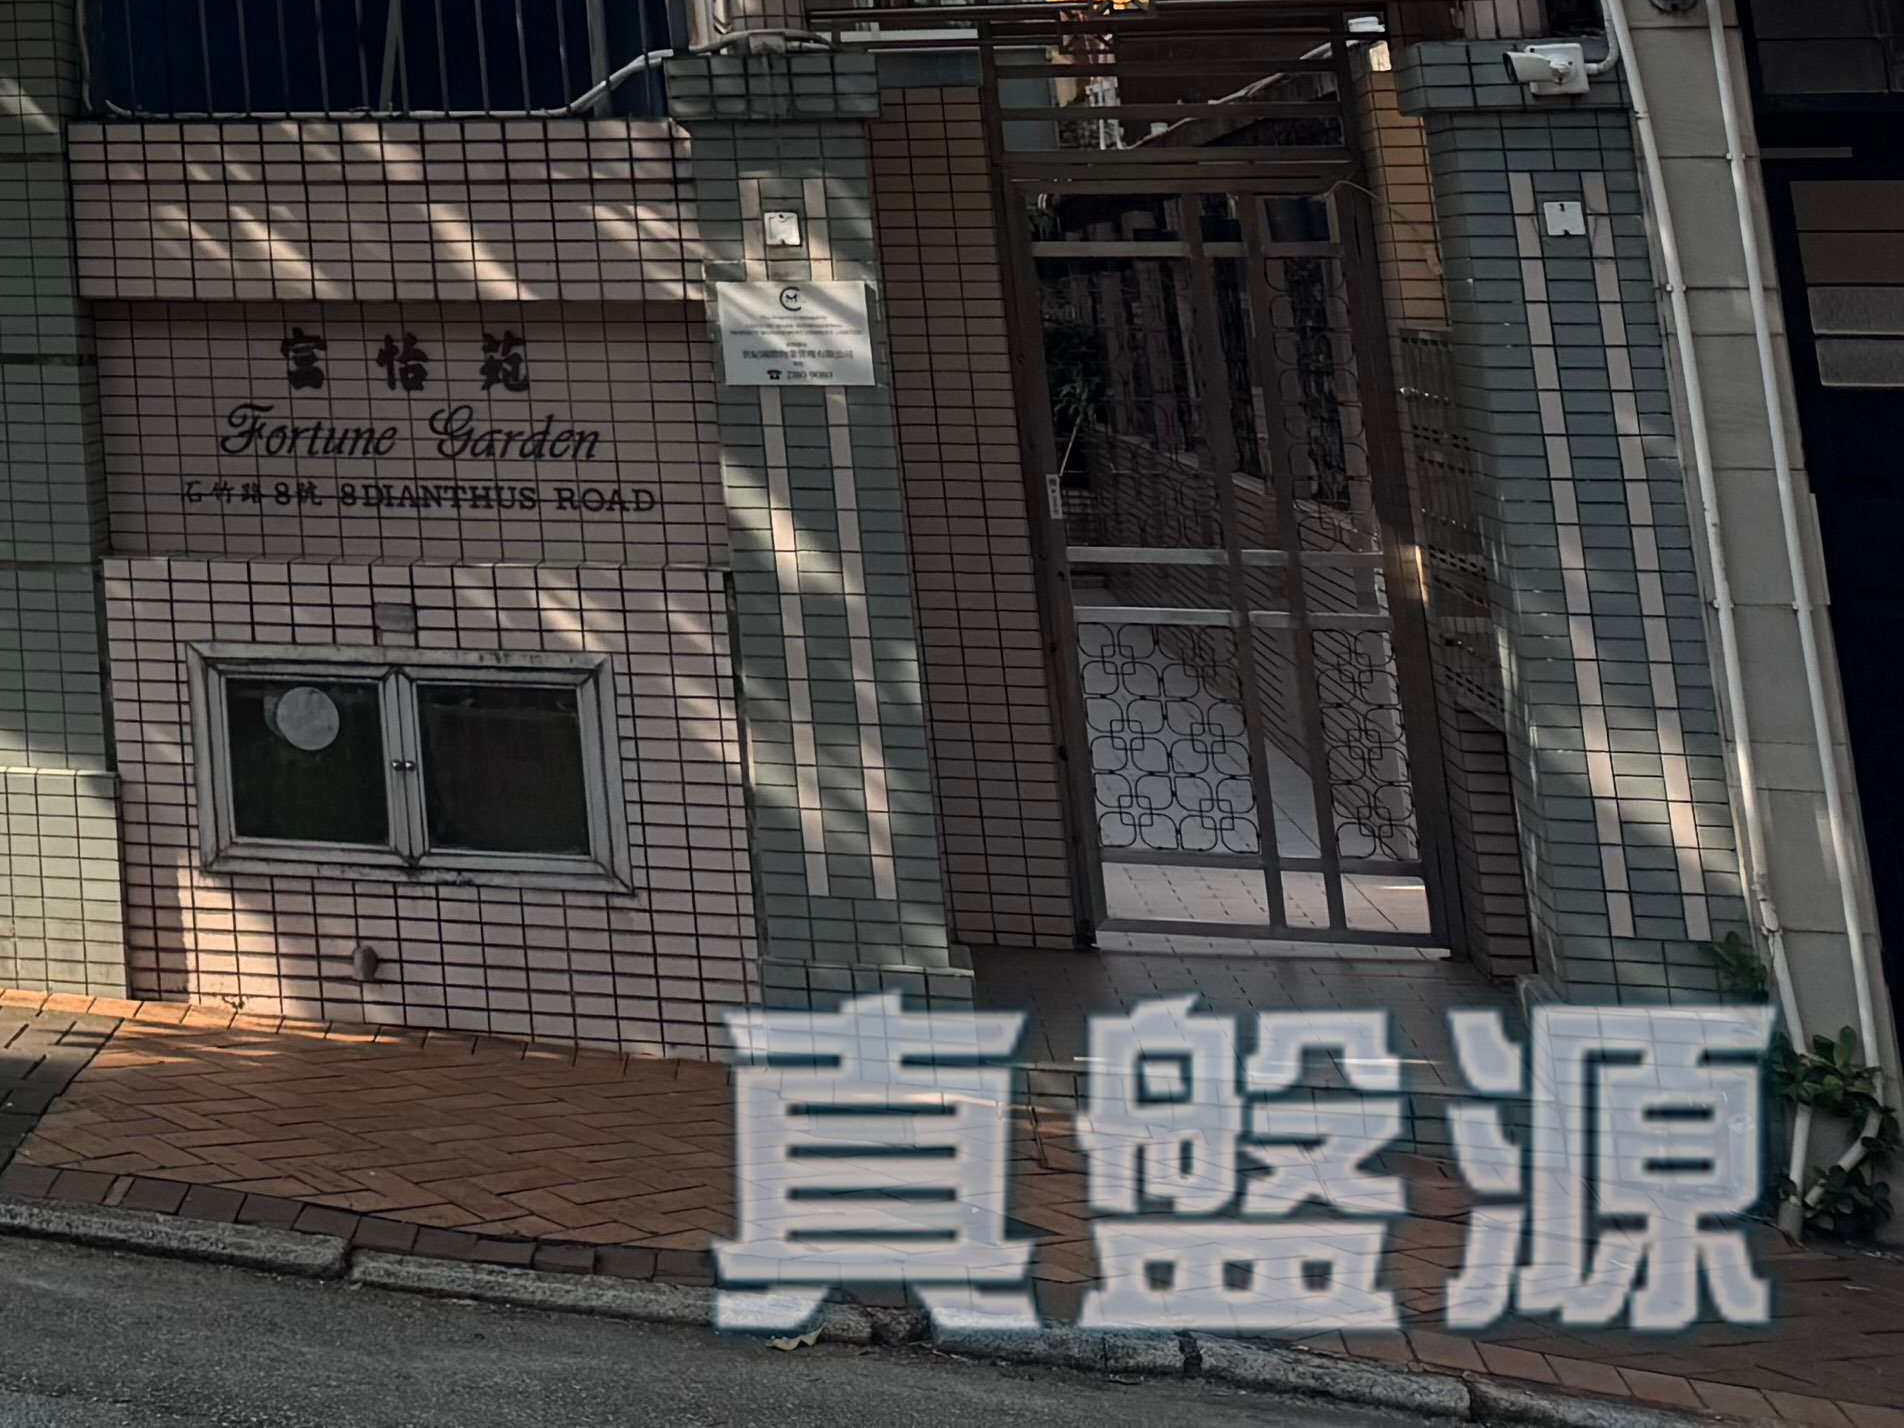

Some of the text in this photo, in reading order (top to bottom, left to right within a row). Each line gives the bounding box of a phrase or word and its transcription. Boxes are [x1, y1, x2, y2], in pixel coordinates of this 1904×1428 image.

[280, 327, 529, 392] 富怡苑
[220, 402, 599, 459] Fortune Garden
[554, 487, 656, 512] ROAD
